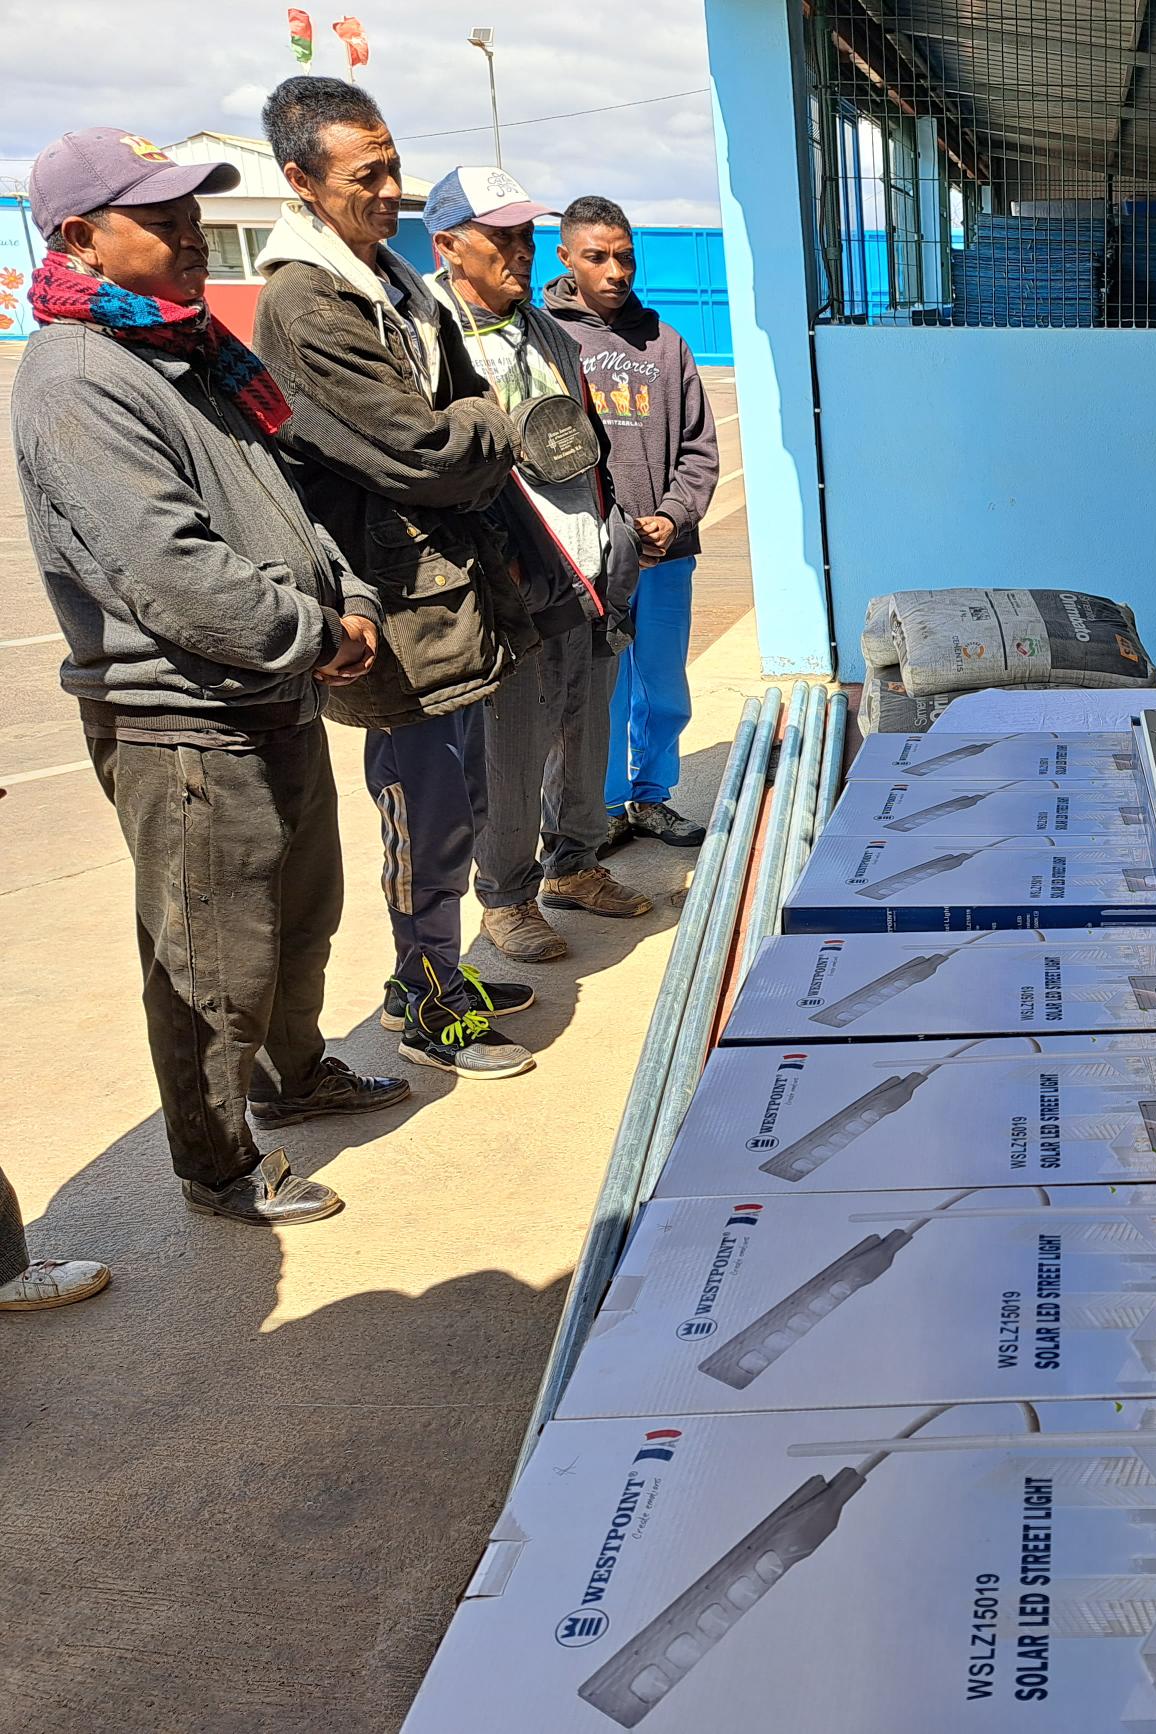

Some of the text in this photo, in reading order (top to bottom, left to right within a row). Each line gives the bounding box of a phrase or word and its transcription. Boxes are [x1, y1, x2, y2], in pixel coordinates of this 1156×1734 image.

[597, 351, 661, 383] Moritz
[807, 956, 829, 997] WESTPOINT
[1044, 971, 1062, 990] STREET
[1044, 990, 1062, 1001] LED
[1044, 1002, 1063, 1021] SOLAR
[759, 1077, 788, 1135] WESTPOINT
[1039, 1073, 1061, 1169] SOLAR LED STREET LIGHT
[1010, 1116, 1028, 1170] WSLZ15019
[695, 1236, 738, 1316] WESTPOINT
[1034, 1234, 1062, 1370] SOLAR LED STREET LIGHT
[997, 1291, 1021, 1369] WSLZ15019
[631, 1477, 662, 1541] Create emotions
[581, 1478, 646, 1606] WESTPOINT
[1013, 1475, 1053, 1702] SOLAR LED STREET LIGHT
[966, 1573, 1000, 1701] WSLZ15019
